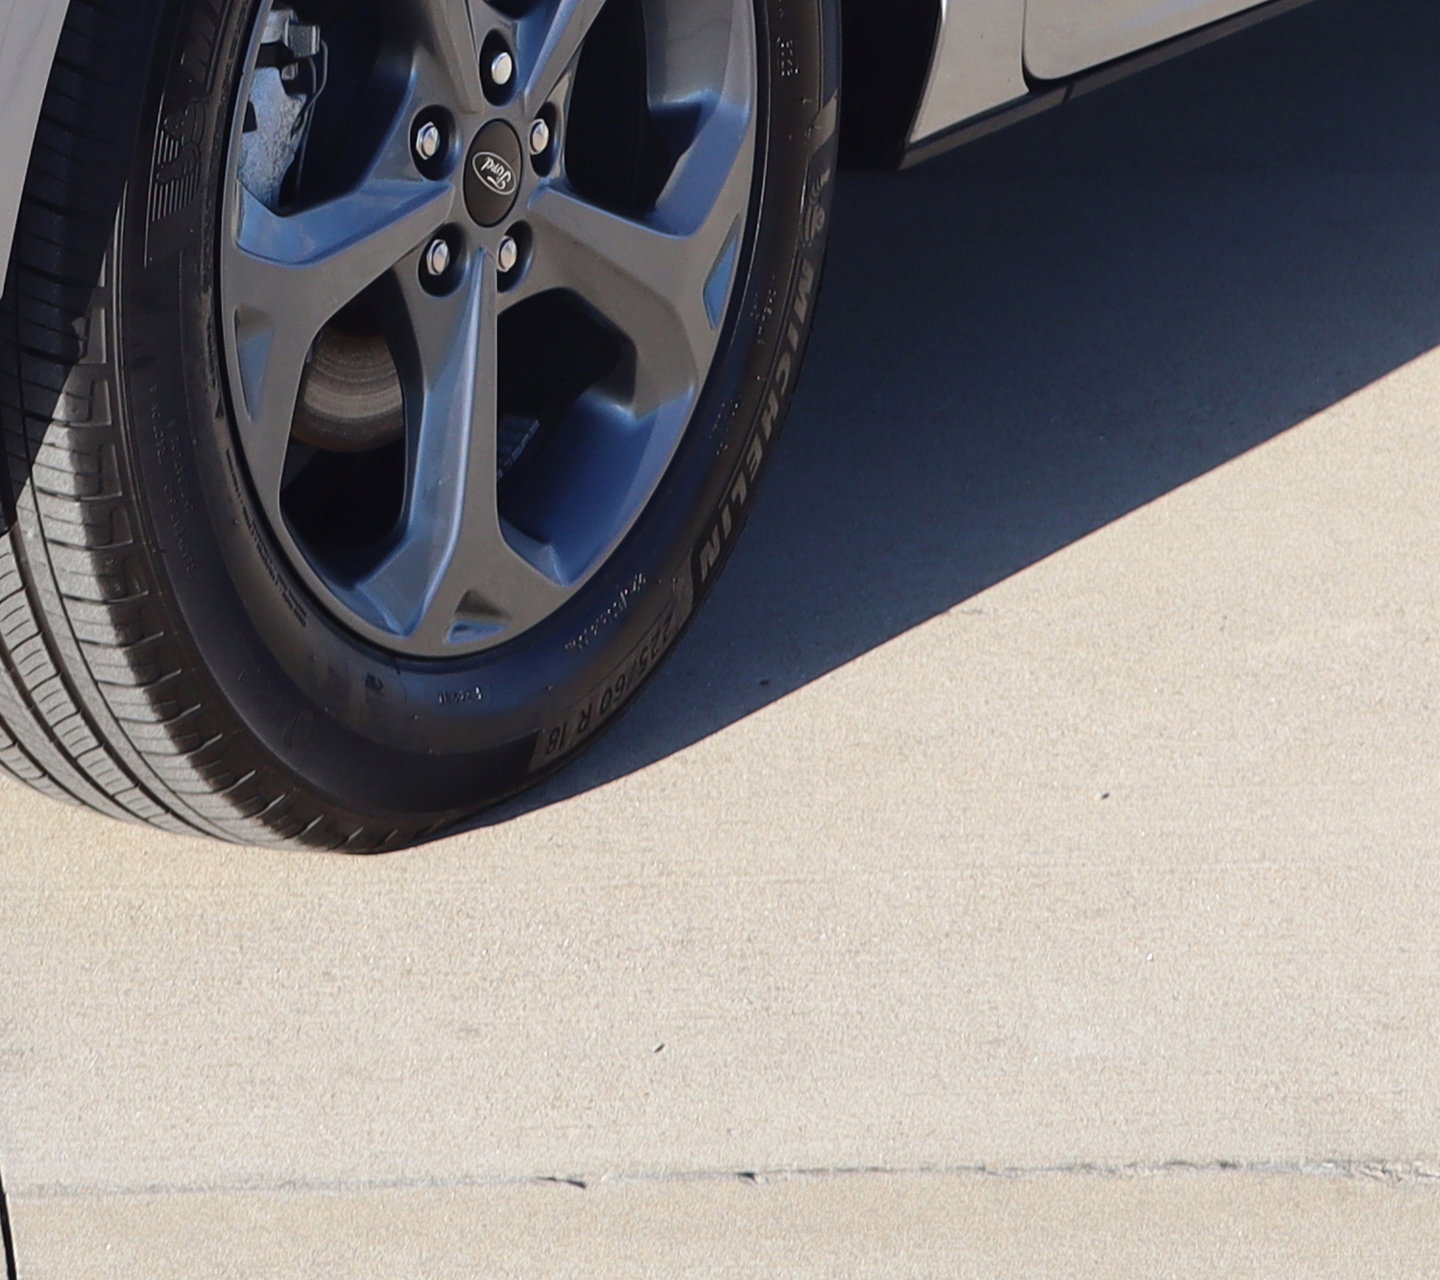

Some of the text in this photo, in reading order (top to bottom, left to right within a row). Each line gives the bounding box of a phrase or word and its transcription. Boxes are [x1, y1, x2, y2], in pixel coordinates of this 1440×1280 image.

[479, 155, 512, 191] Ford
[695, 258, 816, 575] MICHELIN
[599, 612, 673, 715] 225/60
